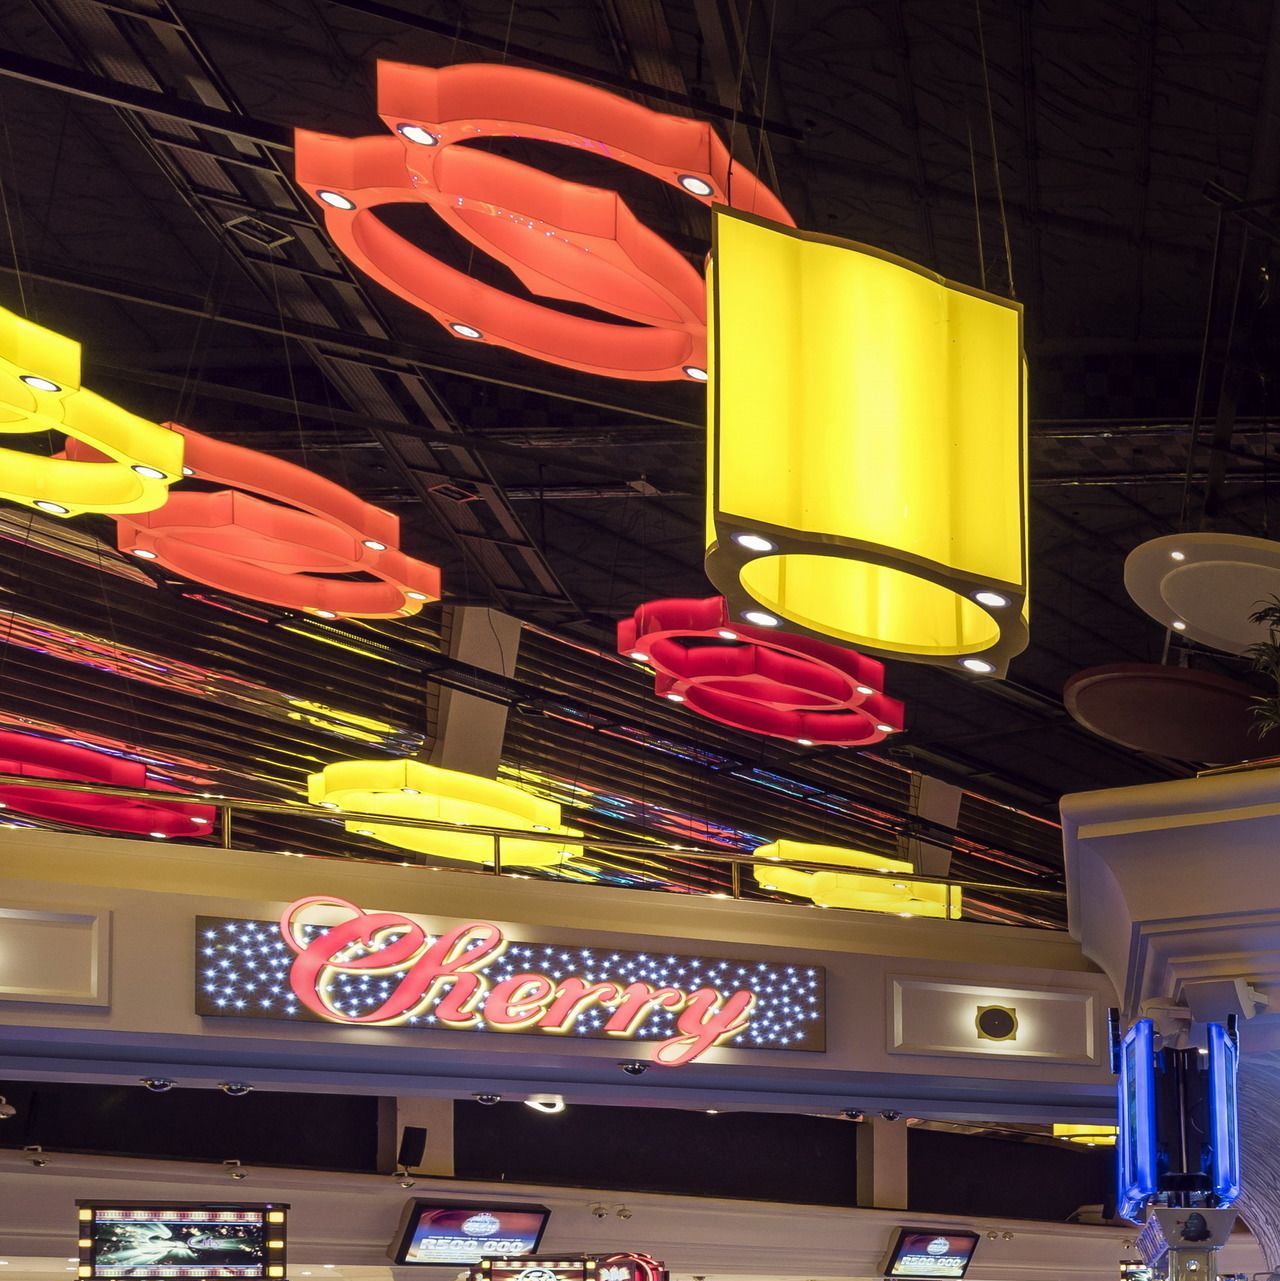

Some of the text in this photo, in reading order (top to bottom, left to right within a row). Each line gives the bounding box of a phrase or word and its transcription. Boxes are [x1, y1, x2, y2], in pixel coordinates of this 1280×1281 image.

[280, 895, 752, 1067] Cherry
[420, 1239, 525, 1252] R500 000
[900, 1256, 935, 1265] R500
[936, 1258, 961, 1267] 000
